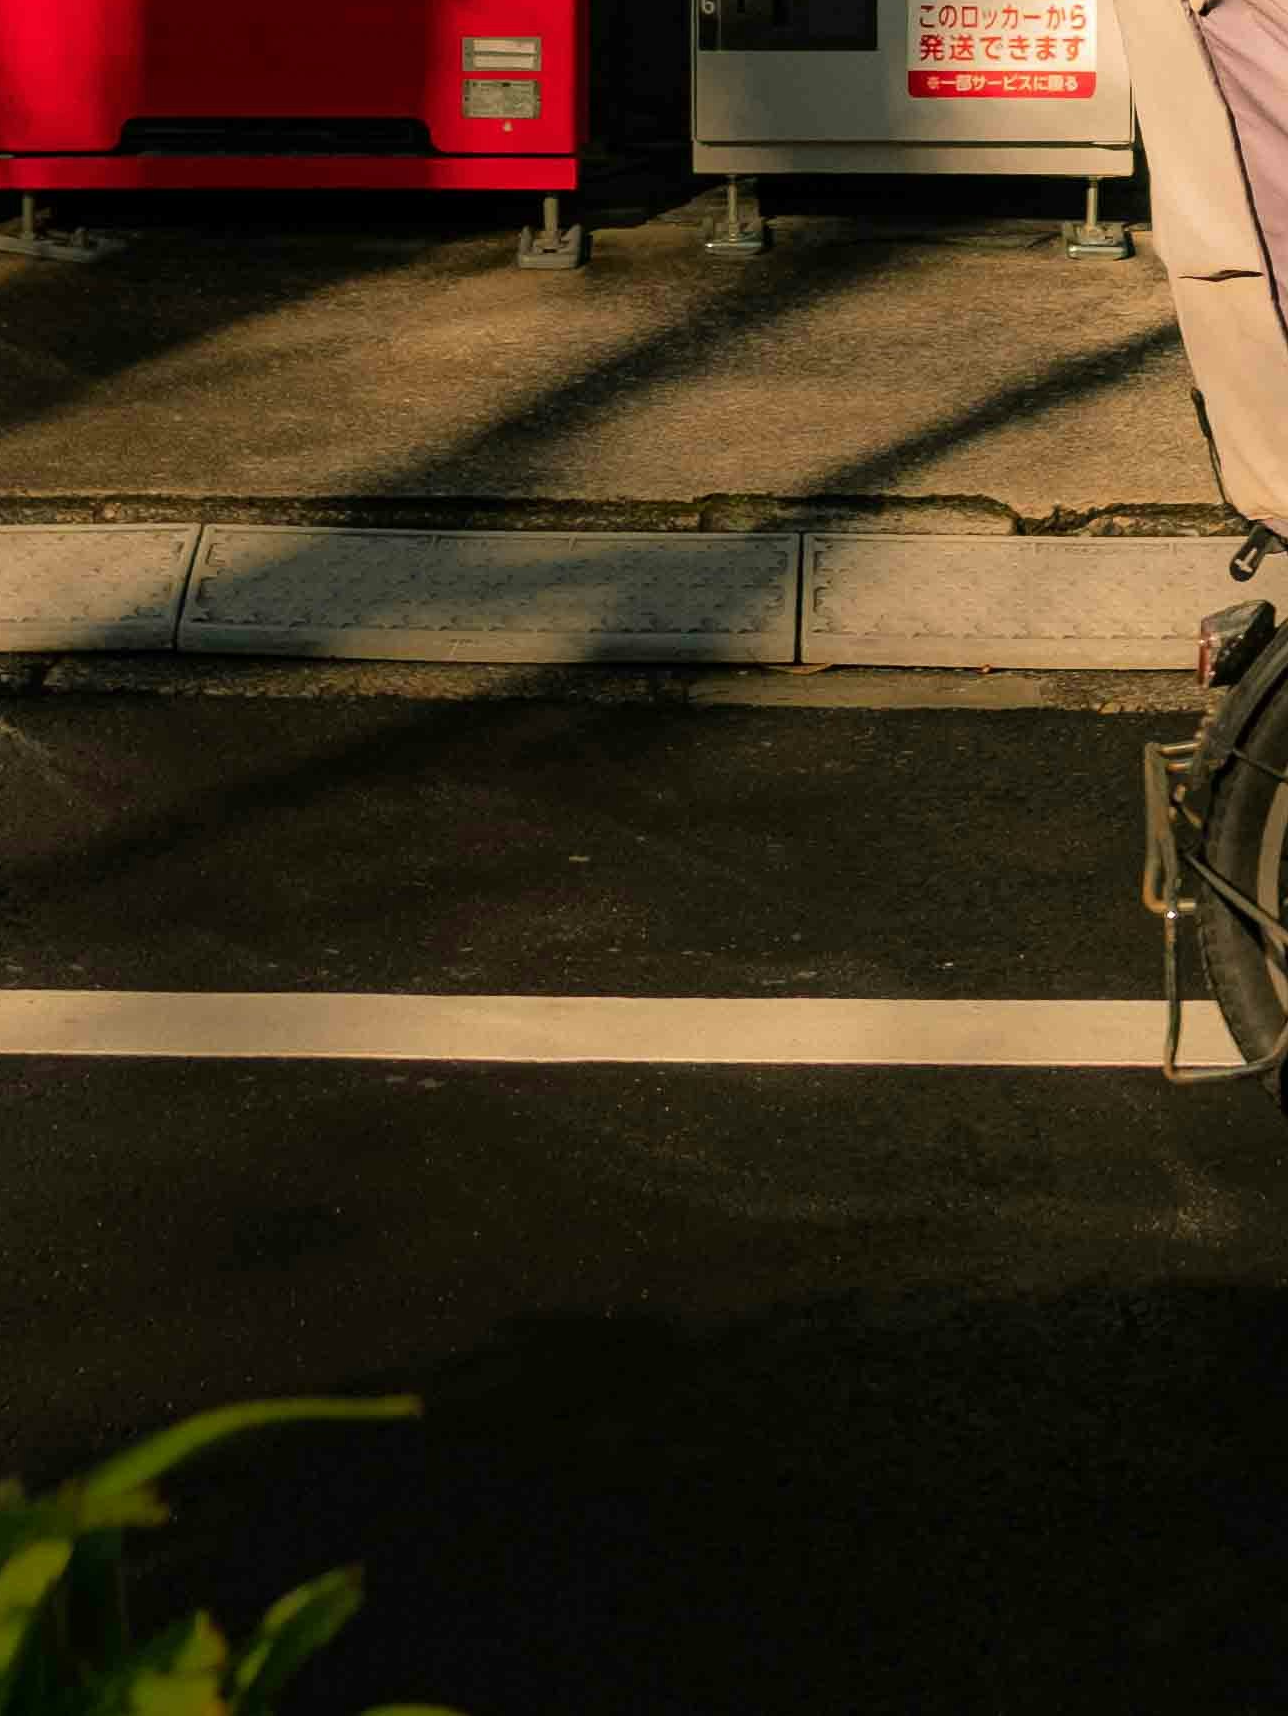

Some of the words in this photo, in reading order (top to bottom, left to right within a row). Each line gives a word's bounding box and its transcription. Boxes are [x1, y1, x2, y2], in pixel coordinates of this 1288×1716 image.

[919, 4, 1087, 31] このロッカーから
[919, 34, 1086, 63] 発送できます
[926, 74, 1079, 93] ※一部サービスに限る
